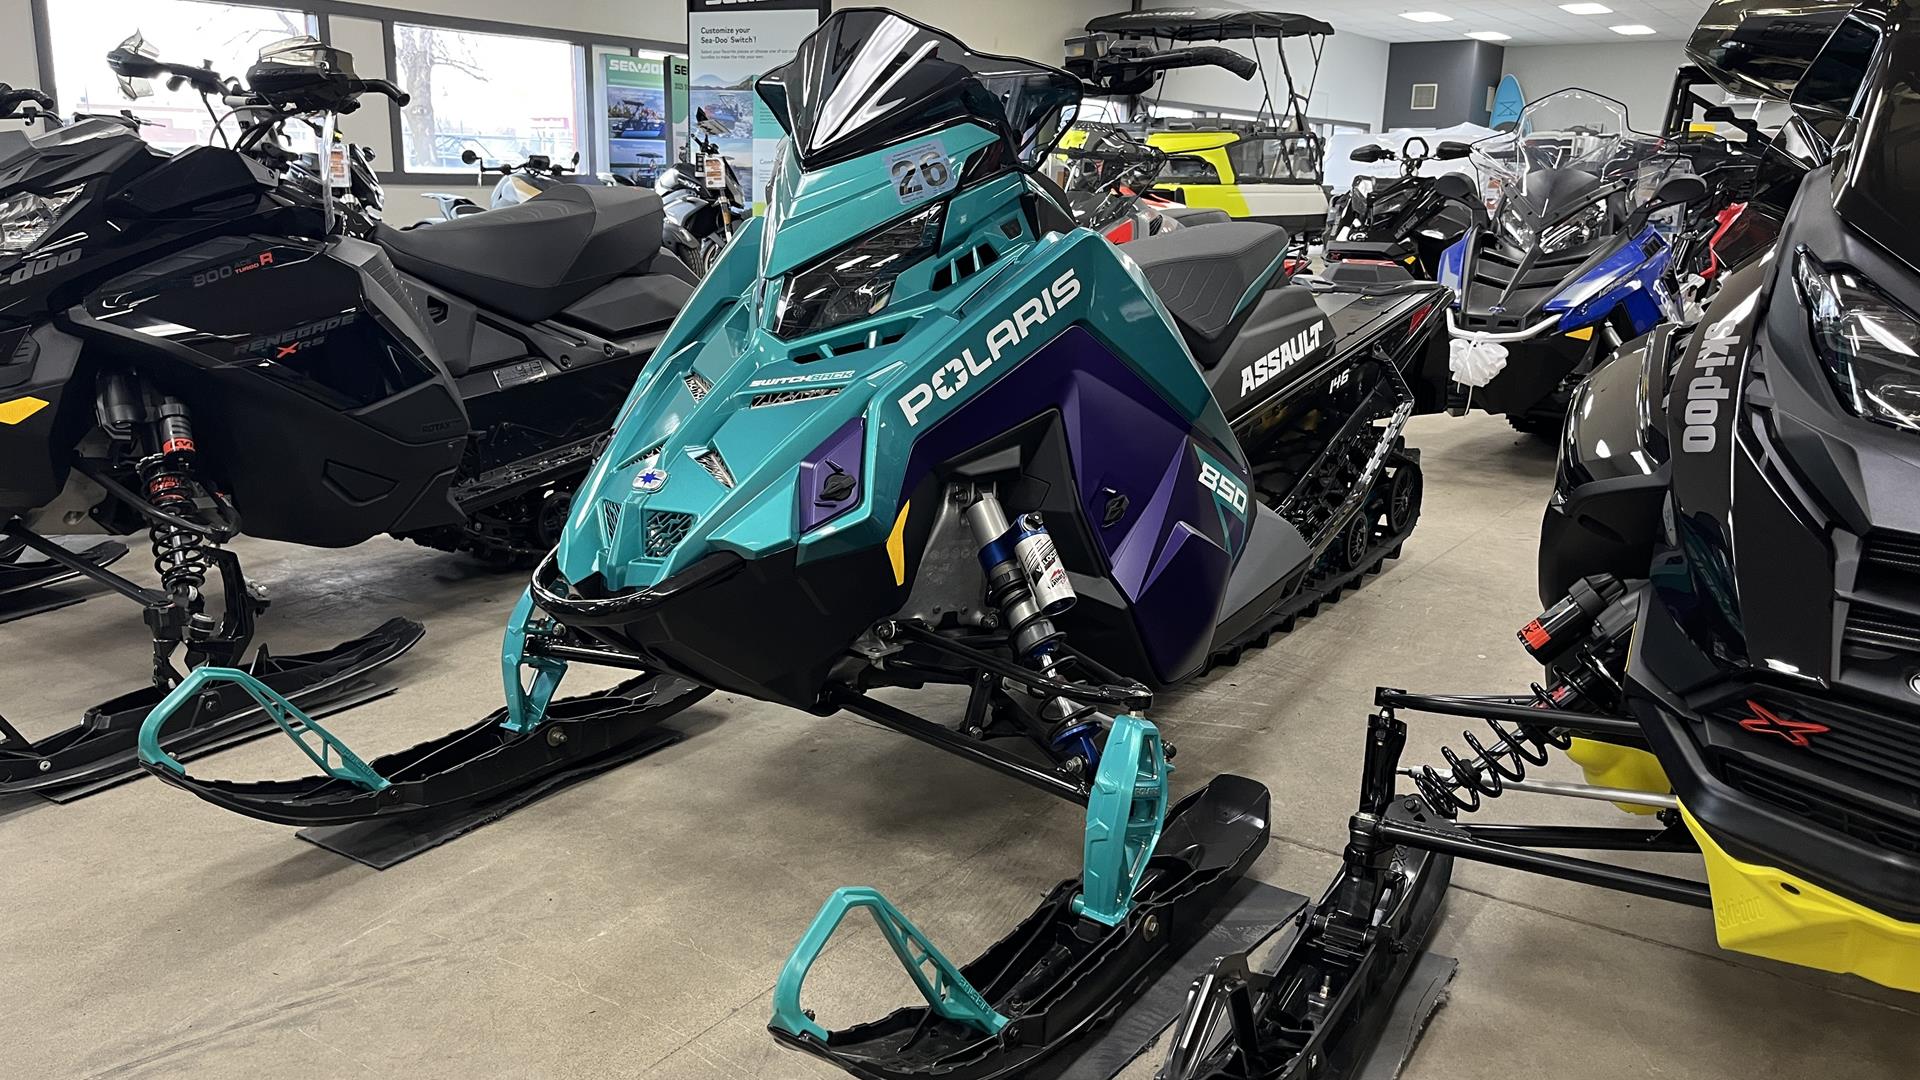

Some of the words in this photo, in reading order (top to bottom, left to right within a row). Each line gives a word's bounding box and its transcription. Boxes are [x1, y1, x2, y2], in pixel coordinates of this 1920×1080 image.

[735, 28, 751, 36] your
[891, 151, 948, 196] 26
[192, 266, 232, 287] 900
[259, 251, 274, 265] R
[234, 315, 355, 355] RENEGADE
[898, 267, 1081, 427] POLARIS
[749, 370, 856, 387] SWITCHBACK
[1240, 320, 1324, 397] ASSAULT
[1329, 368, 1350, 395] 146
[1682, 319, 1741, 453] ski-doo
[1198, 461, 1248, 514] 850
